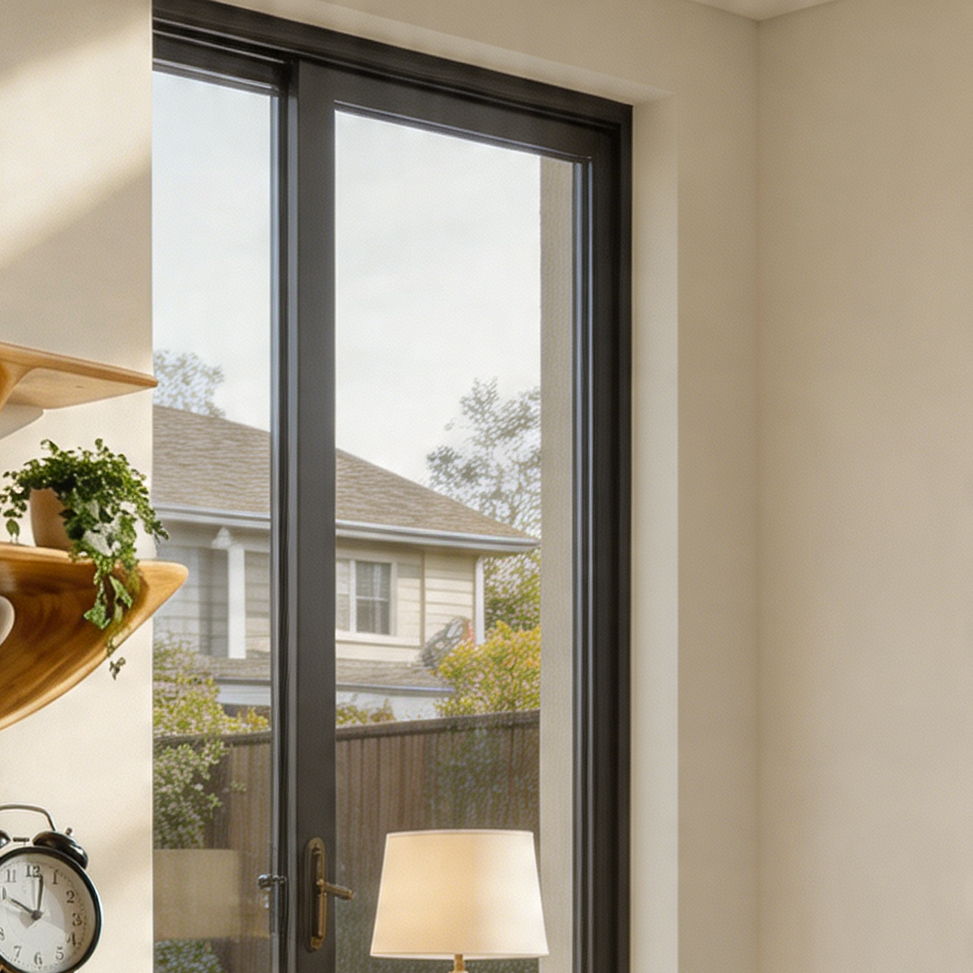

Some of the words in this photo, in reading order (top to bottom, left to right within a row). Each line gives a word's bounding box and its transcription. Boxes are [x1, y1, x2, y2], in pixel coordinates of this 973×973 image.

[66, 890, 75, 904] 2
[13, 945, 22, 959] 7
[34, 952, 43, 966] 6
[55, 946, 64, 960] 5
